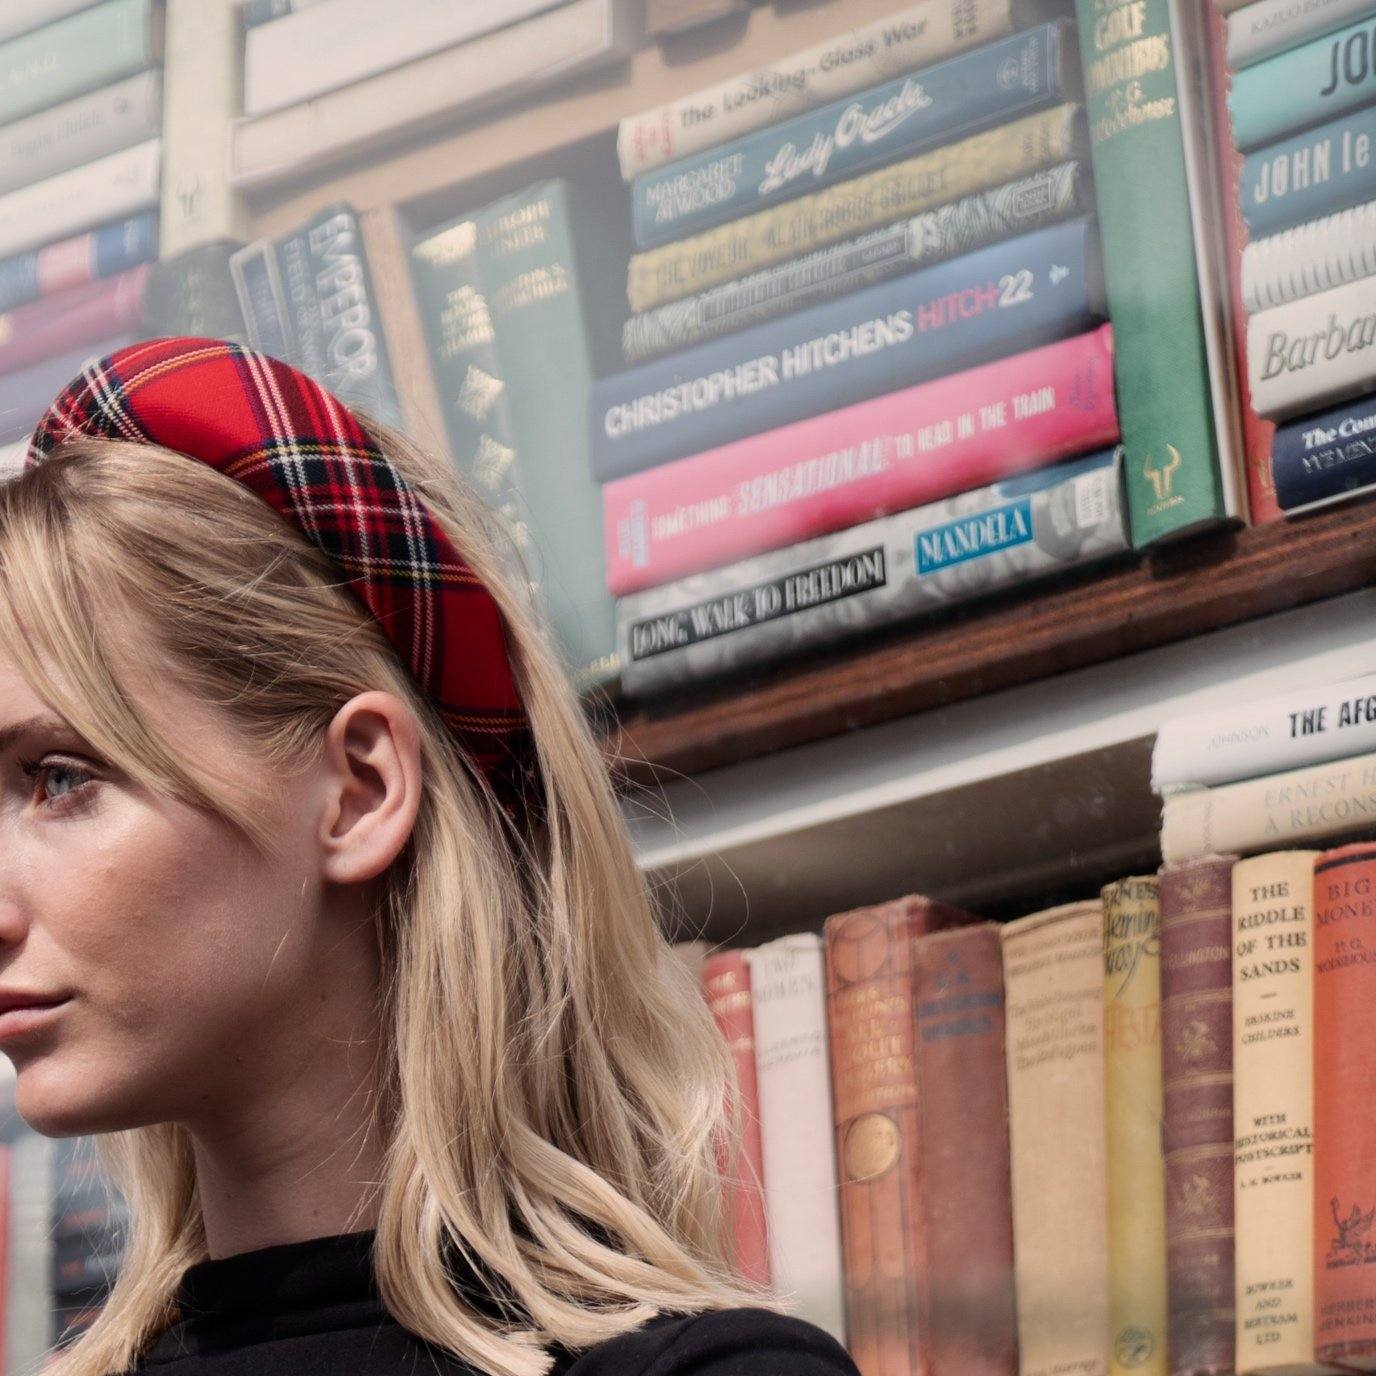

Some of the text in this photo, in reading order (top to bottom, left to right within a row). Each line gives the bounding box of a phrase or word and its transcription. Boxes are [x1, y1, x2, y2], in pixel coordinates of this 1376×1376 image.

[1320, 28, 1376, 96] JO
[1254, 130, 1370, 204] JOHN le
[604, 356, 780, 439] CHRISTOPHER
[782, 309, 914, 380] HITCHENS
[736, 436, 889, 516] SENSATIONAL
[982, 402, 1007, 430] THE
[1012, 386, 1055, 420] TRAIN
[1301, 425, 1338, 450] The
[919, 510, 1030, 567] MANDELA
[631, 549, 885, 656] LONG WALK TO FREEDOM
[1289, 706, 1328, 739] THE
[1250, 882, 1291, 902] THE
[1327, 878, 1372, 903] BIG
[1238, 905, 1306, 932] RIDDLE
[1316, 900, 1376, 926] MONE
[1236, 931, 1307, 957] OF THE
[1240, 958, 1301, 982] SANDS
